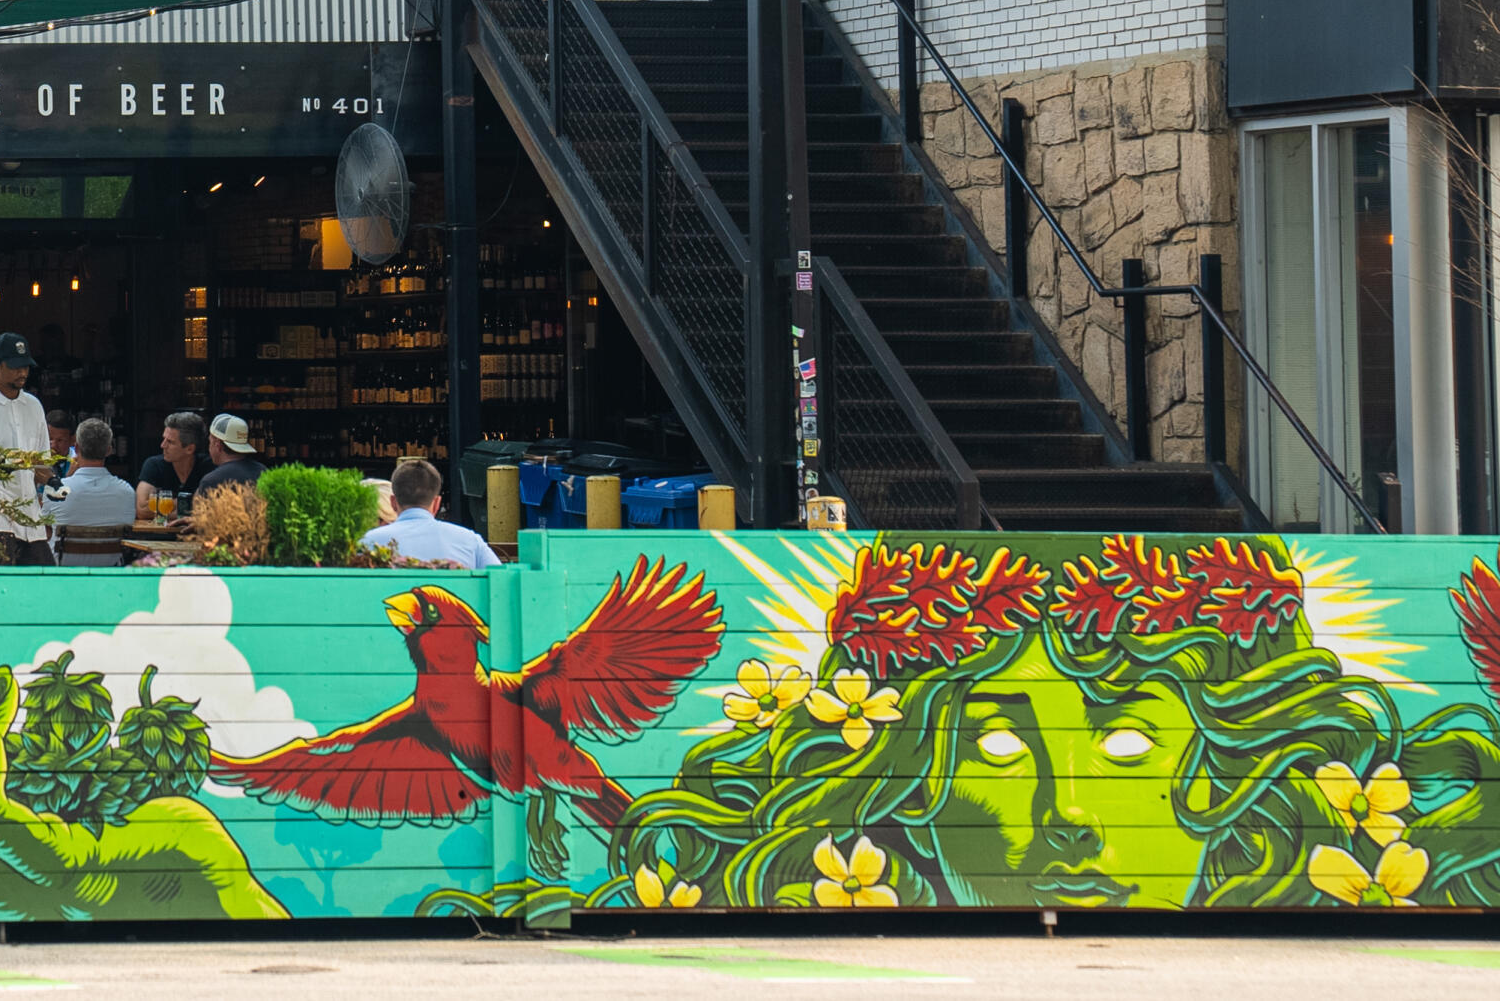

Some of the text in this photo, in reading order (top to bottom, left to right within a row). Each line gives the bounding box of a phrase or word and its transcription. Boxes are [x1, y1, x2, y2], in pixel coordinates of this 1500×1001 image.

[37, 83, 83, 117] OF
[120, 83, 225, 116] BEER
[331, 97, 384, 114] 401
